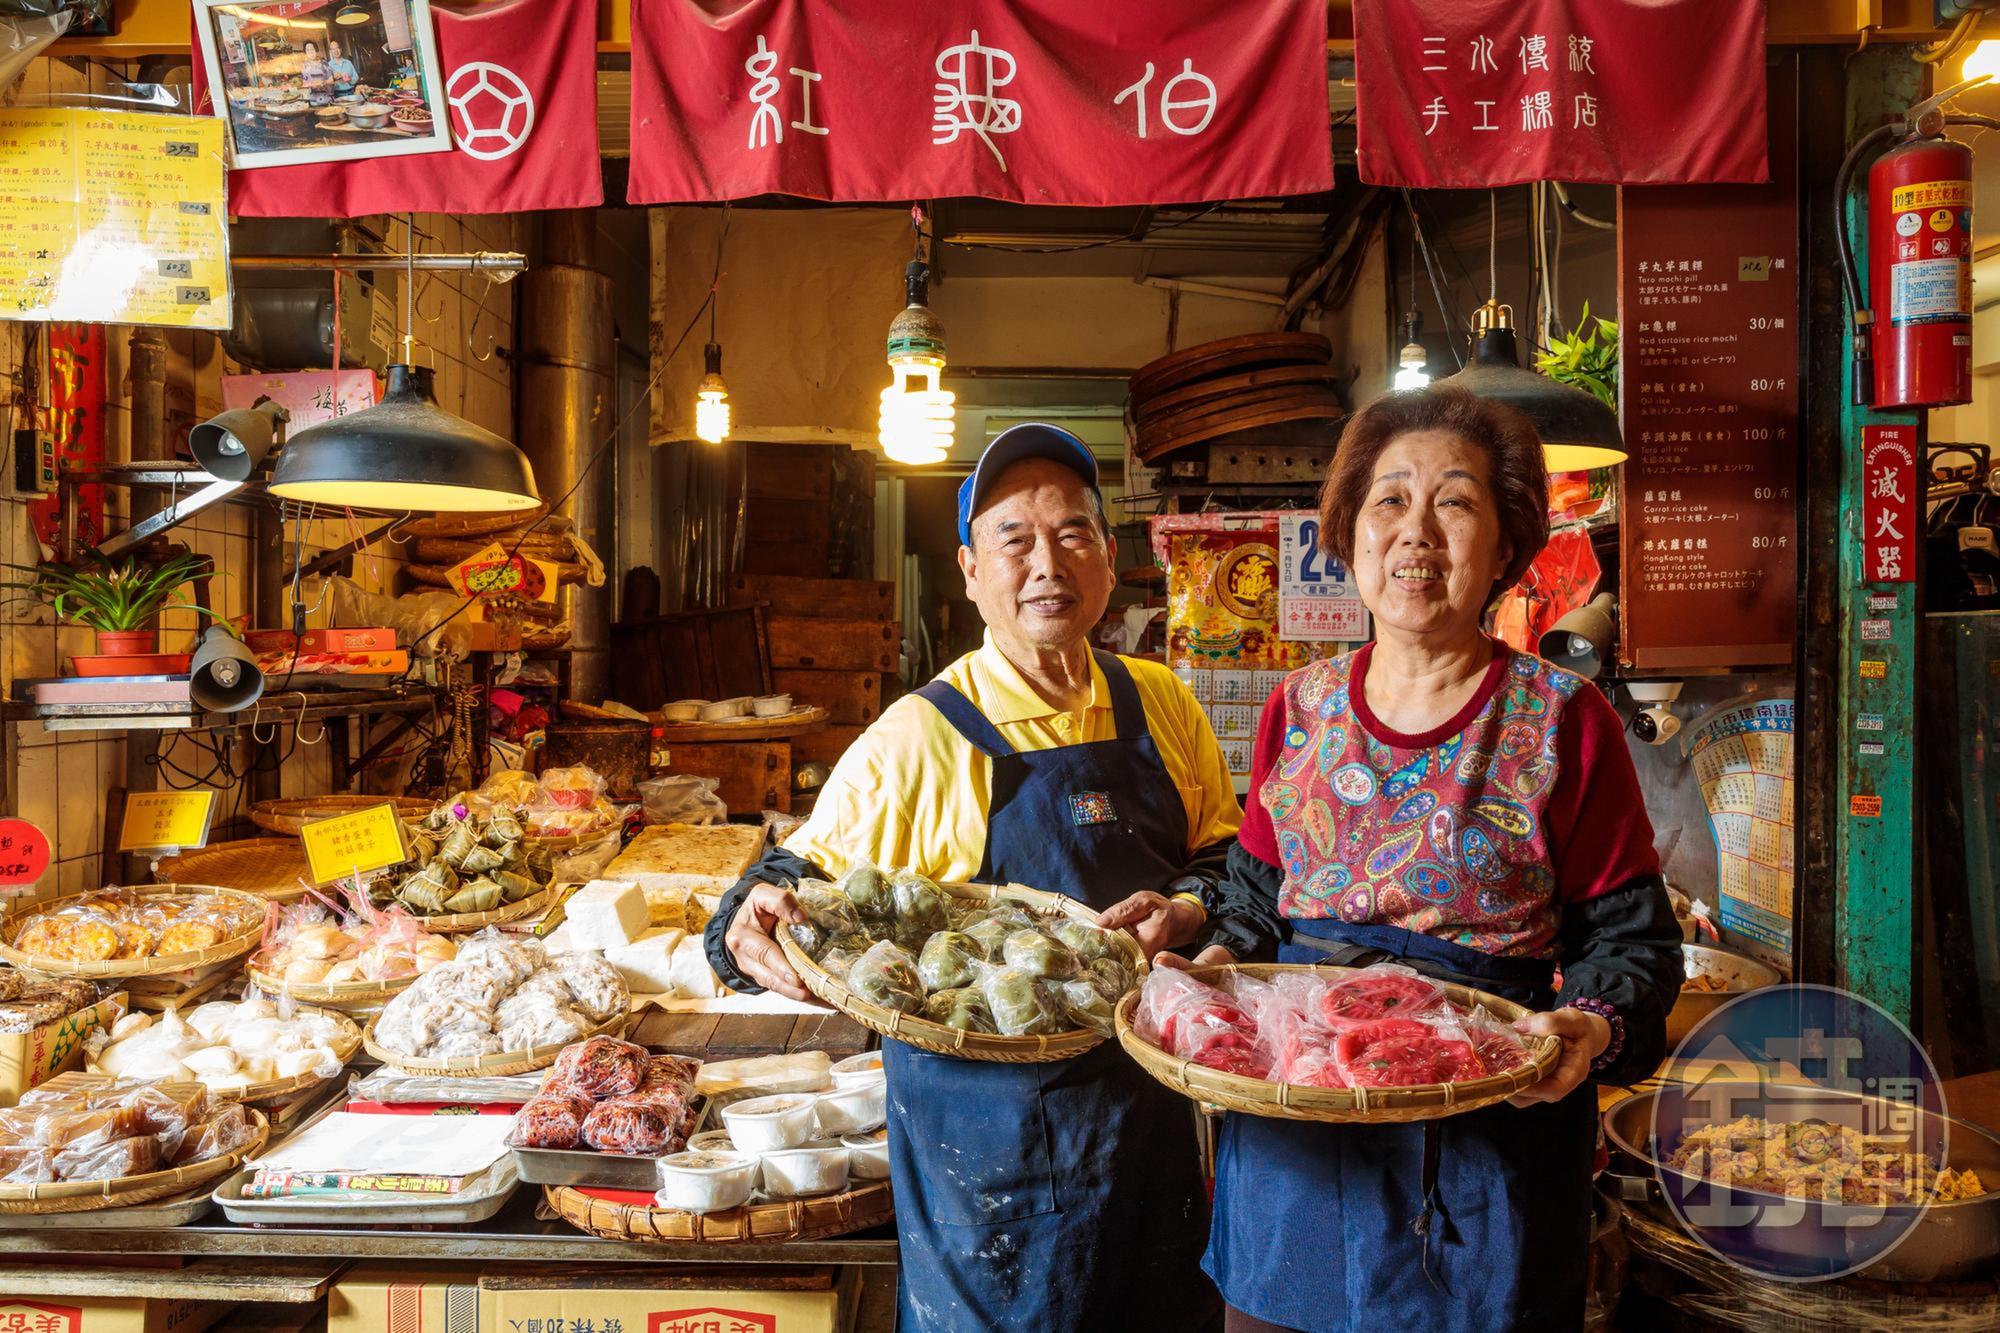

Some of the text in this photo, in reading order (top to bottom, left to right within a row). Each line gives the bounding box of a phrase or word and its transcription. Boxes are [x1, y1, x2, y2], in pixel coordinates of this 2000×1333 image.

[1423, 34, 1595, 75] 三水傳統
[1423, 91, 1597, 136] 手工粿店
[1939, 211, 1946, 220] B
[1658, 275, 1682, 283] mochi
[1685, 275, 1698, 284] pill
[1639, 337, 1656, 345] Red
[1658, 336, 1690, 344] tortoise
[1712, 335, 1738, 343] mochi
[1751, 378, 1786, 391] 80/斤
[1743, 428, 1787, 441] 100/斤
[1880, 431, 1899, 439] FIRE
[1866, 441, 1913, 466] EXTINGUISHER
[1754, 487, 1789, 500] 60/斤
[1644, 505, 1670, 513] Carrot
[1871, 466, 1905, 579] 滅火器
[1752, 536, 1787, 548] 80/斤
[1299, 520, 1346, 582] 24
[1686, 553, 1704, 562] style
[1643, 562, 1707, 571] Carrot rice cake
[1308, 585, 1338, 595] 星期二
